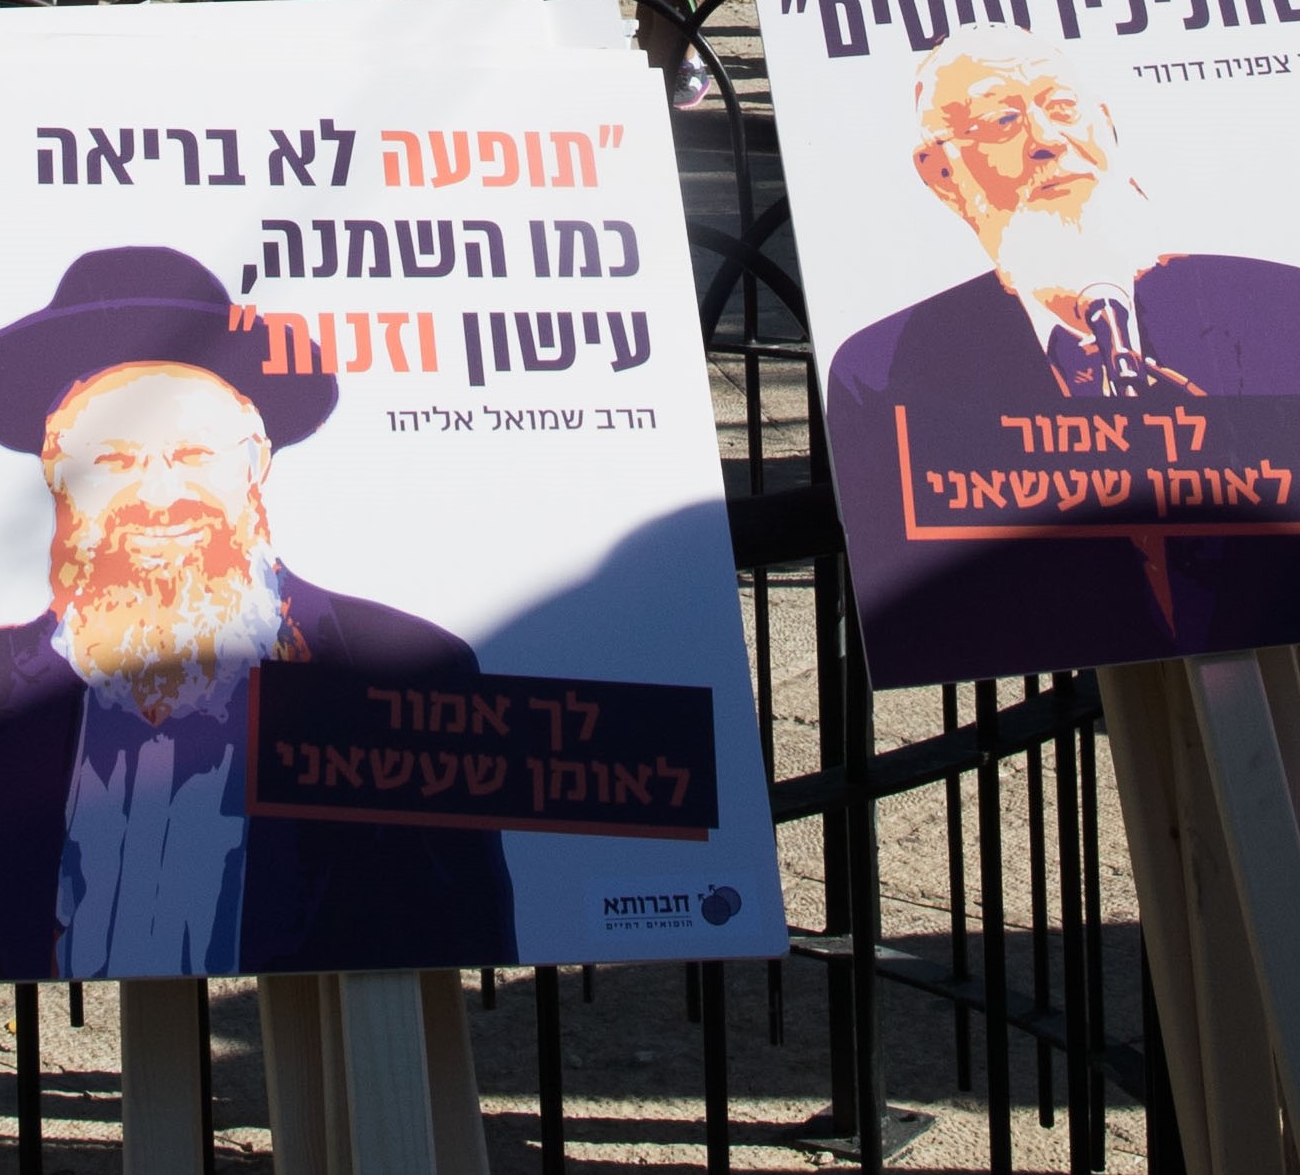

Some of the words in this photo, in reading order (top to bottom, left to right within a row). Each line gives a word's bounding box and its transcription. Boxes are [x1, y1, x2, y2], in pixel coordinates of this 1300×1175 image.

[1133, 61, 1205, 84] דרורי
[1214, 54, 1291, 79] צפניה
[37, 126, 245, 186] בריאה
[268, 118, 357, 187] לא
[381, 124, 624, 188] "תופעה
[240, 216, 508, 294] השמנה,
[529, 220, 640, 279] כמו
[227, 304, 439, 376] וזנות"
[463, 310, 653, 387] עישון
[386, 404, 475, 433] אליהו
[483, 402, 585, 431] שמואל
[595, 405, 658, 431] הרב
[1000, 411, 1131, 454] אמור
[1143, 406, 1207, 462] לך
[926, 468, 1131, 512] שעשאני
[1147, 460, 1293, 517] לאומן
[367, 686, 511, 735] אמור
[529, 690, 600, 752] לך
[275, 740, 508, 797] שעשאני
[526, 755, 691, 812] לאומן
[604, 894, 690, 916] חברותא
